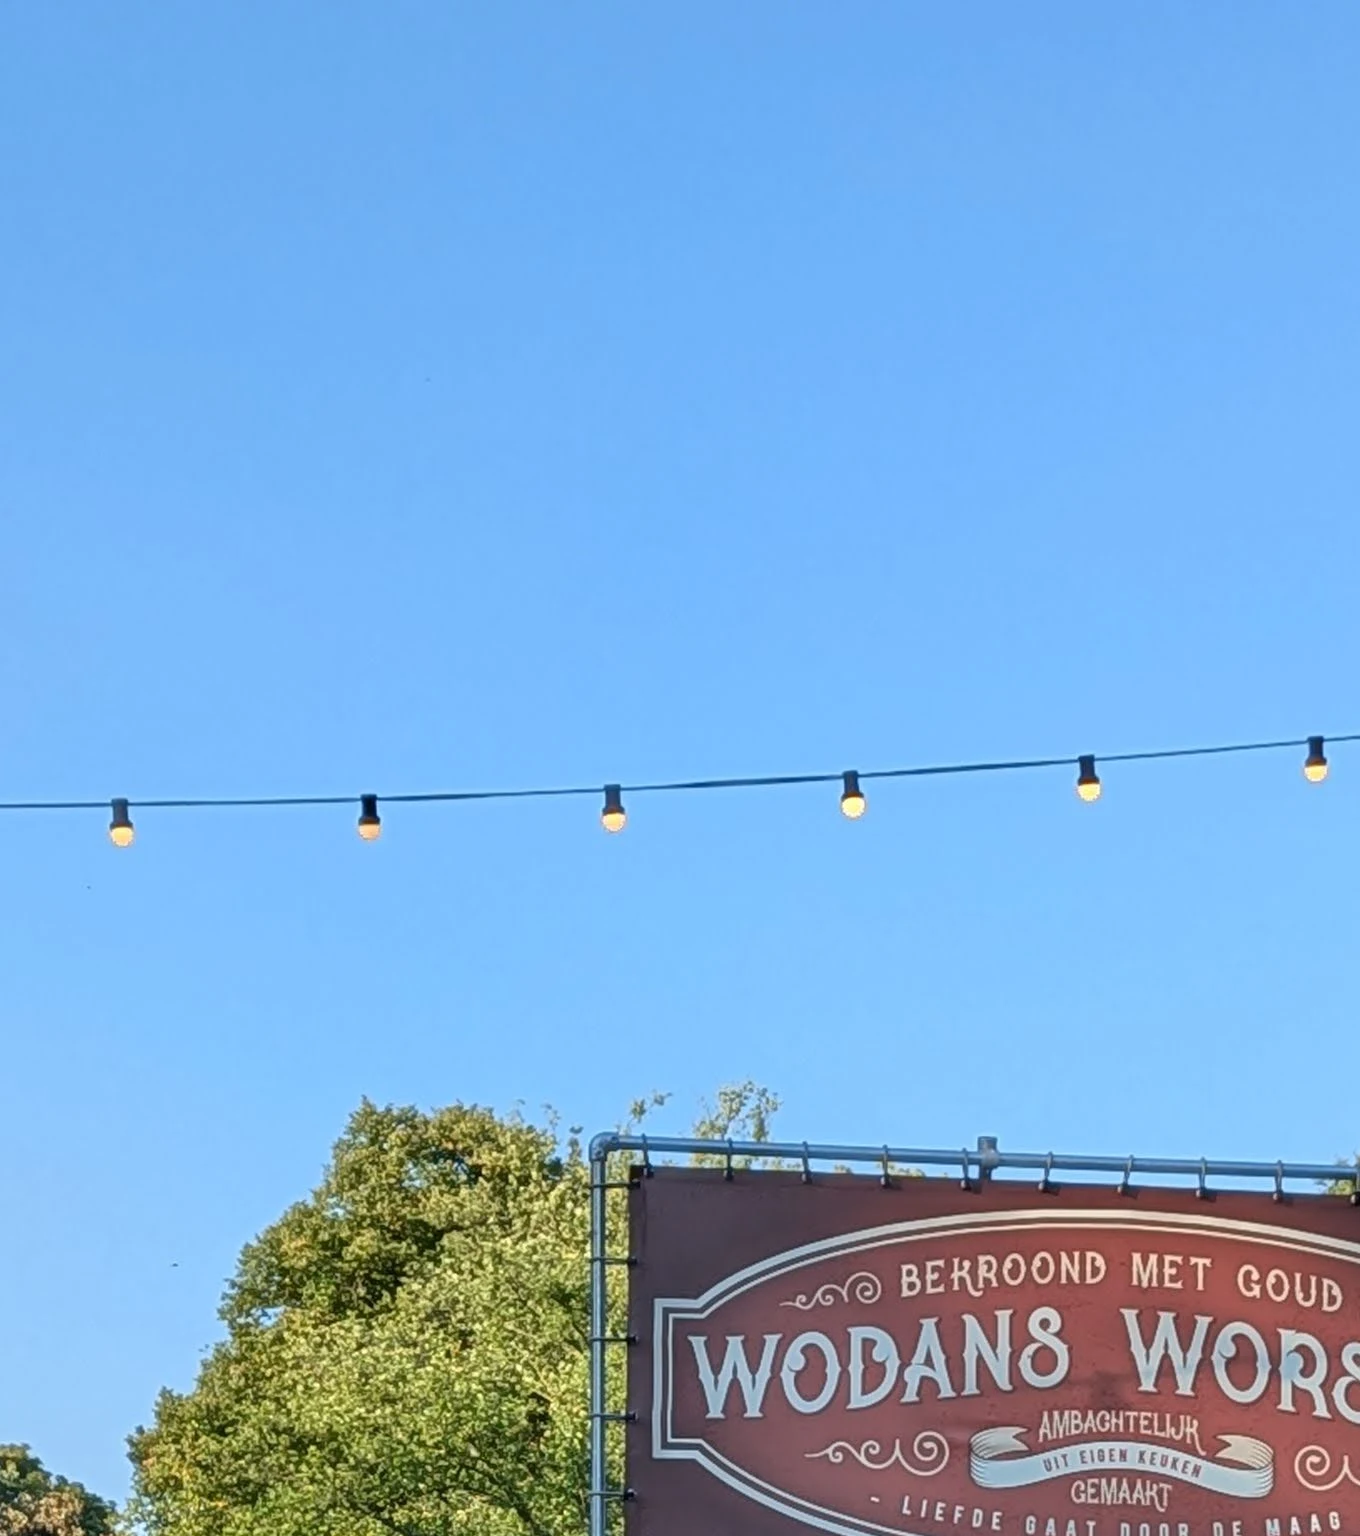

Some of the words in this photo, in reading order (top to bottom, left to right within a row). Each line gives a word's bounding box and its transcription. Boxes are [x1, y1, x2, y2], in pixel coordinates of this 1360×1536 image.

[900, 1251, 1107, 1298] BEKROOND
[1131, 1252, 1213, 1291] MET
[1237, 1264, 1343, 1312] GOUD
[687, 1306, 1070, 1419] WODANS
[1038, 1410, 1207, 1456] AMBACHTELIJK
[1043, 1454, 1070, 1472] UIT
[1080, 1448, 1128, 1464] EIGEN
[1137, 1451, 1203, 1478] KEUKEN
[902, 1495, 1003, 1531] LIEFDE
[1070, 1477, 1173, 1512] GEMAAKT
